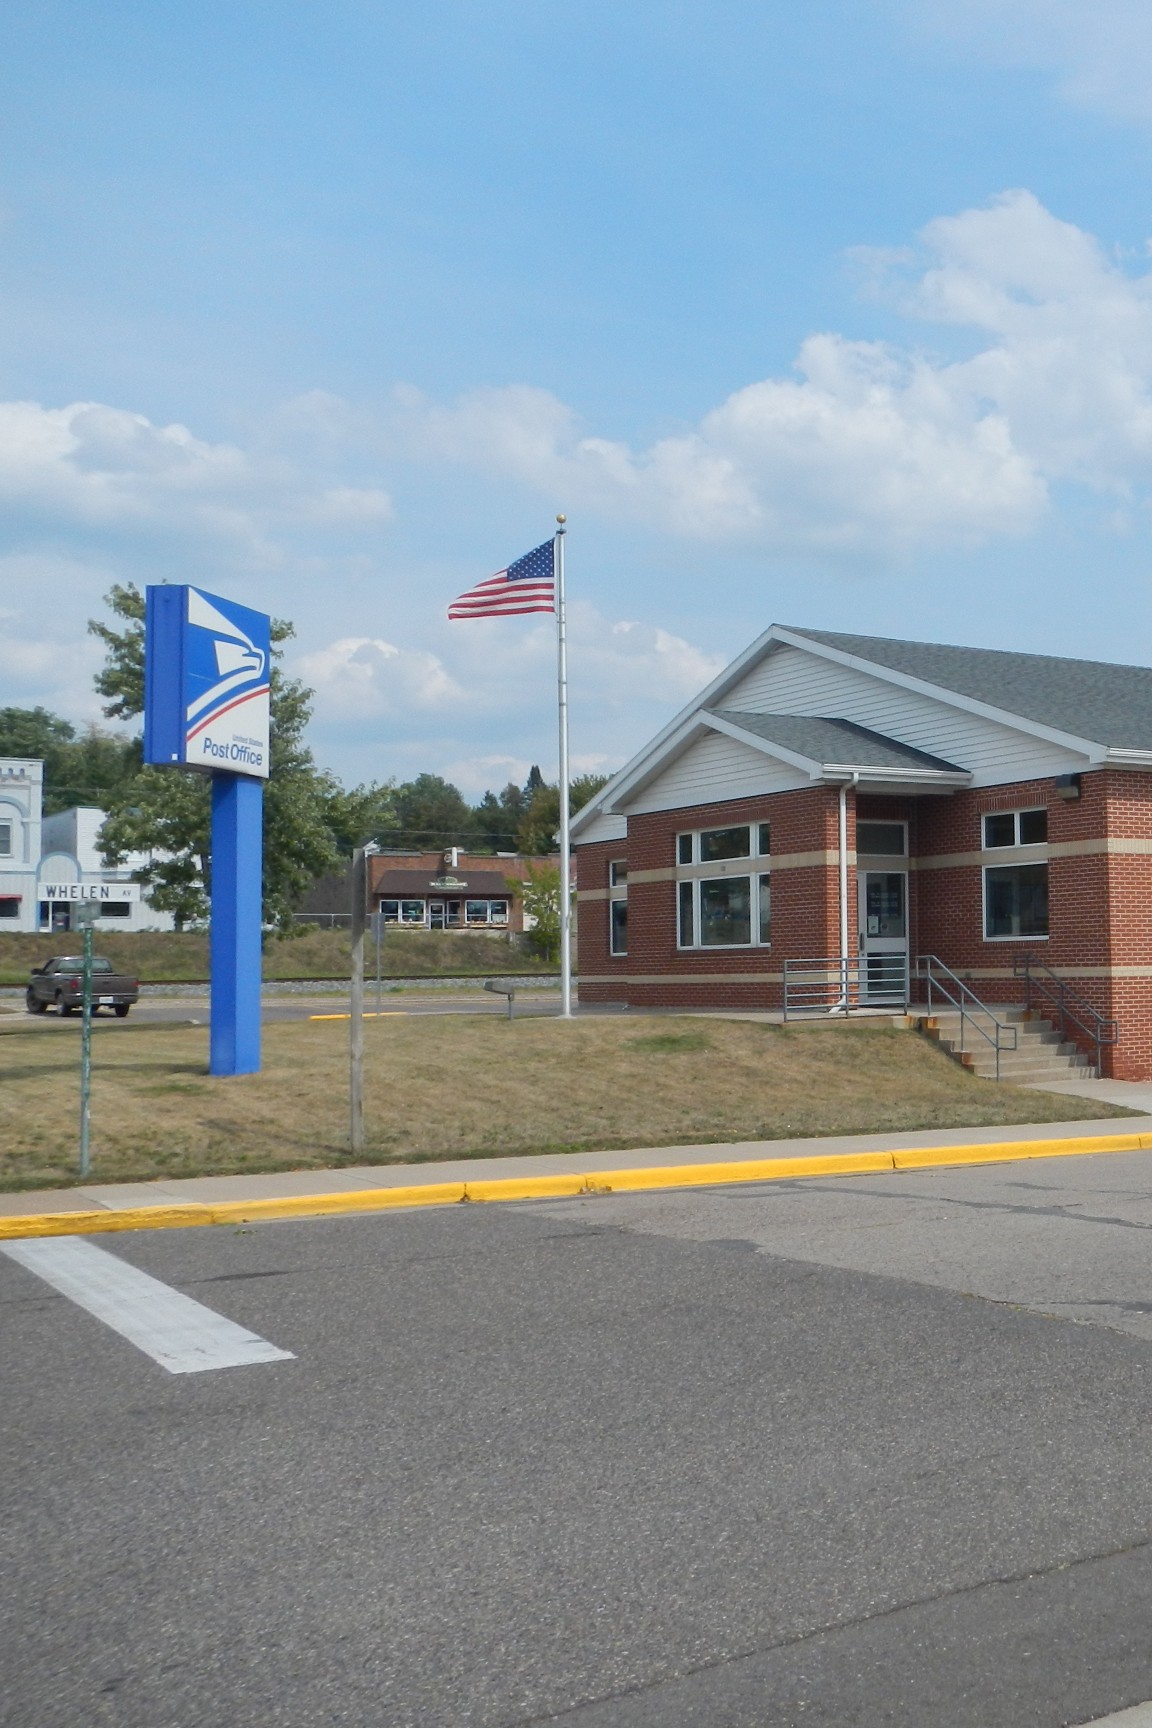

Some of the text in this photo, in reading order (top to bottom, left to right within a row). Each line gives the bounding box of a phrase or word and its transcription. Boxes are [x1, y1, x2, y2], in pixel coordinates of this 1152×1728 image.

[203, 737, 229, 758] Post
[230, 743, 263, 766] Office
[46, 885, 109, 899] WHELEN
